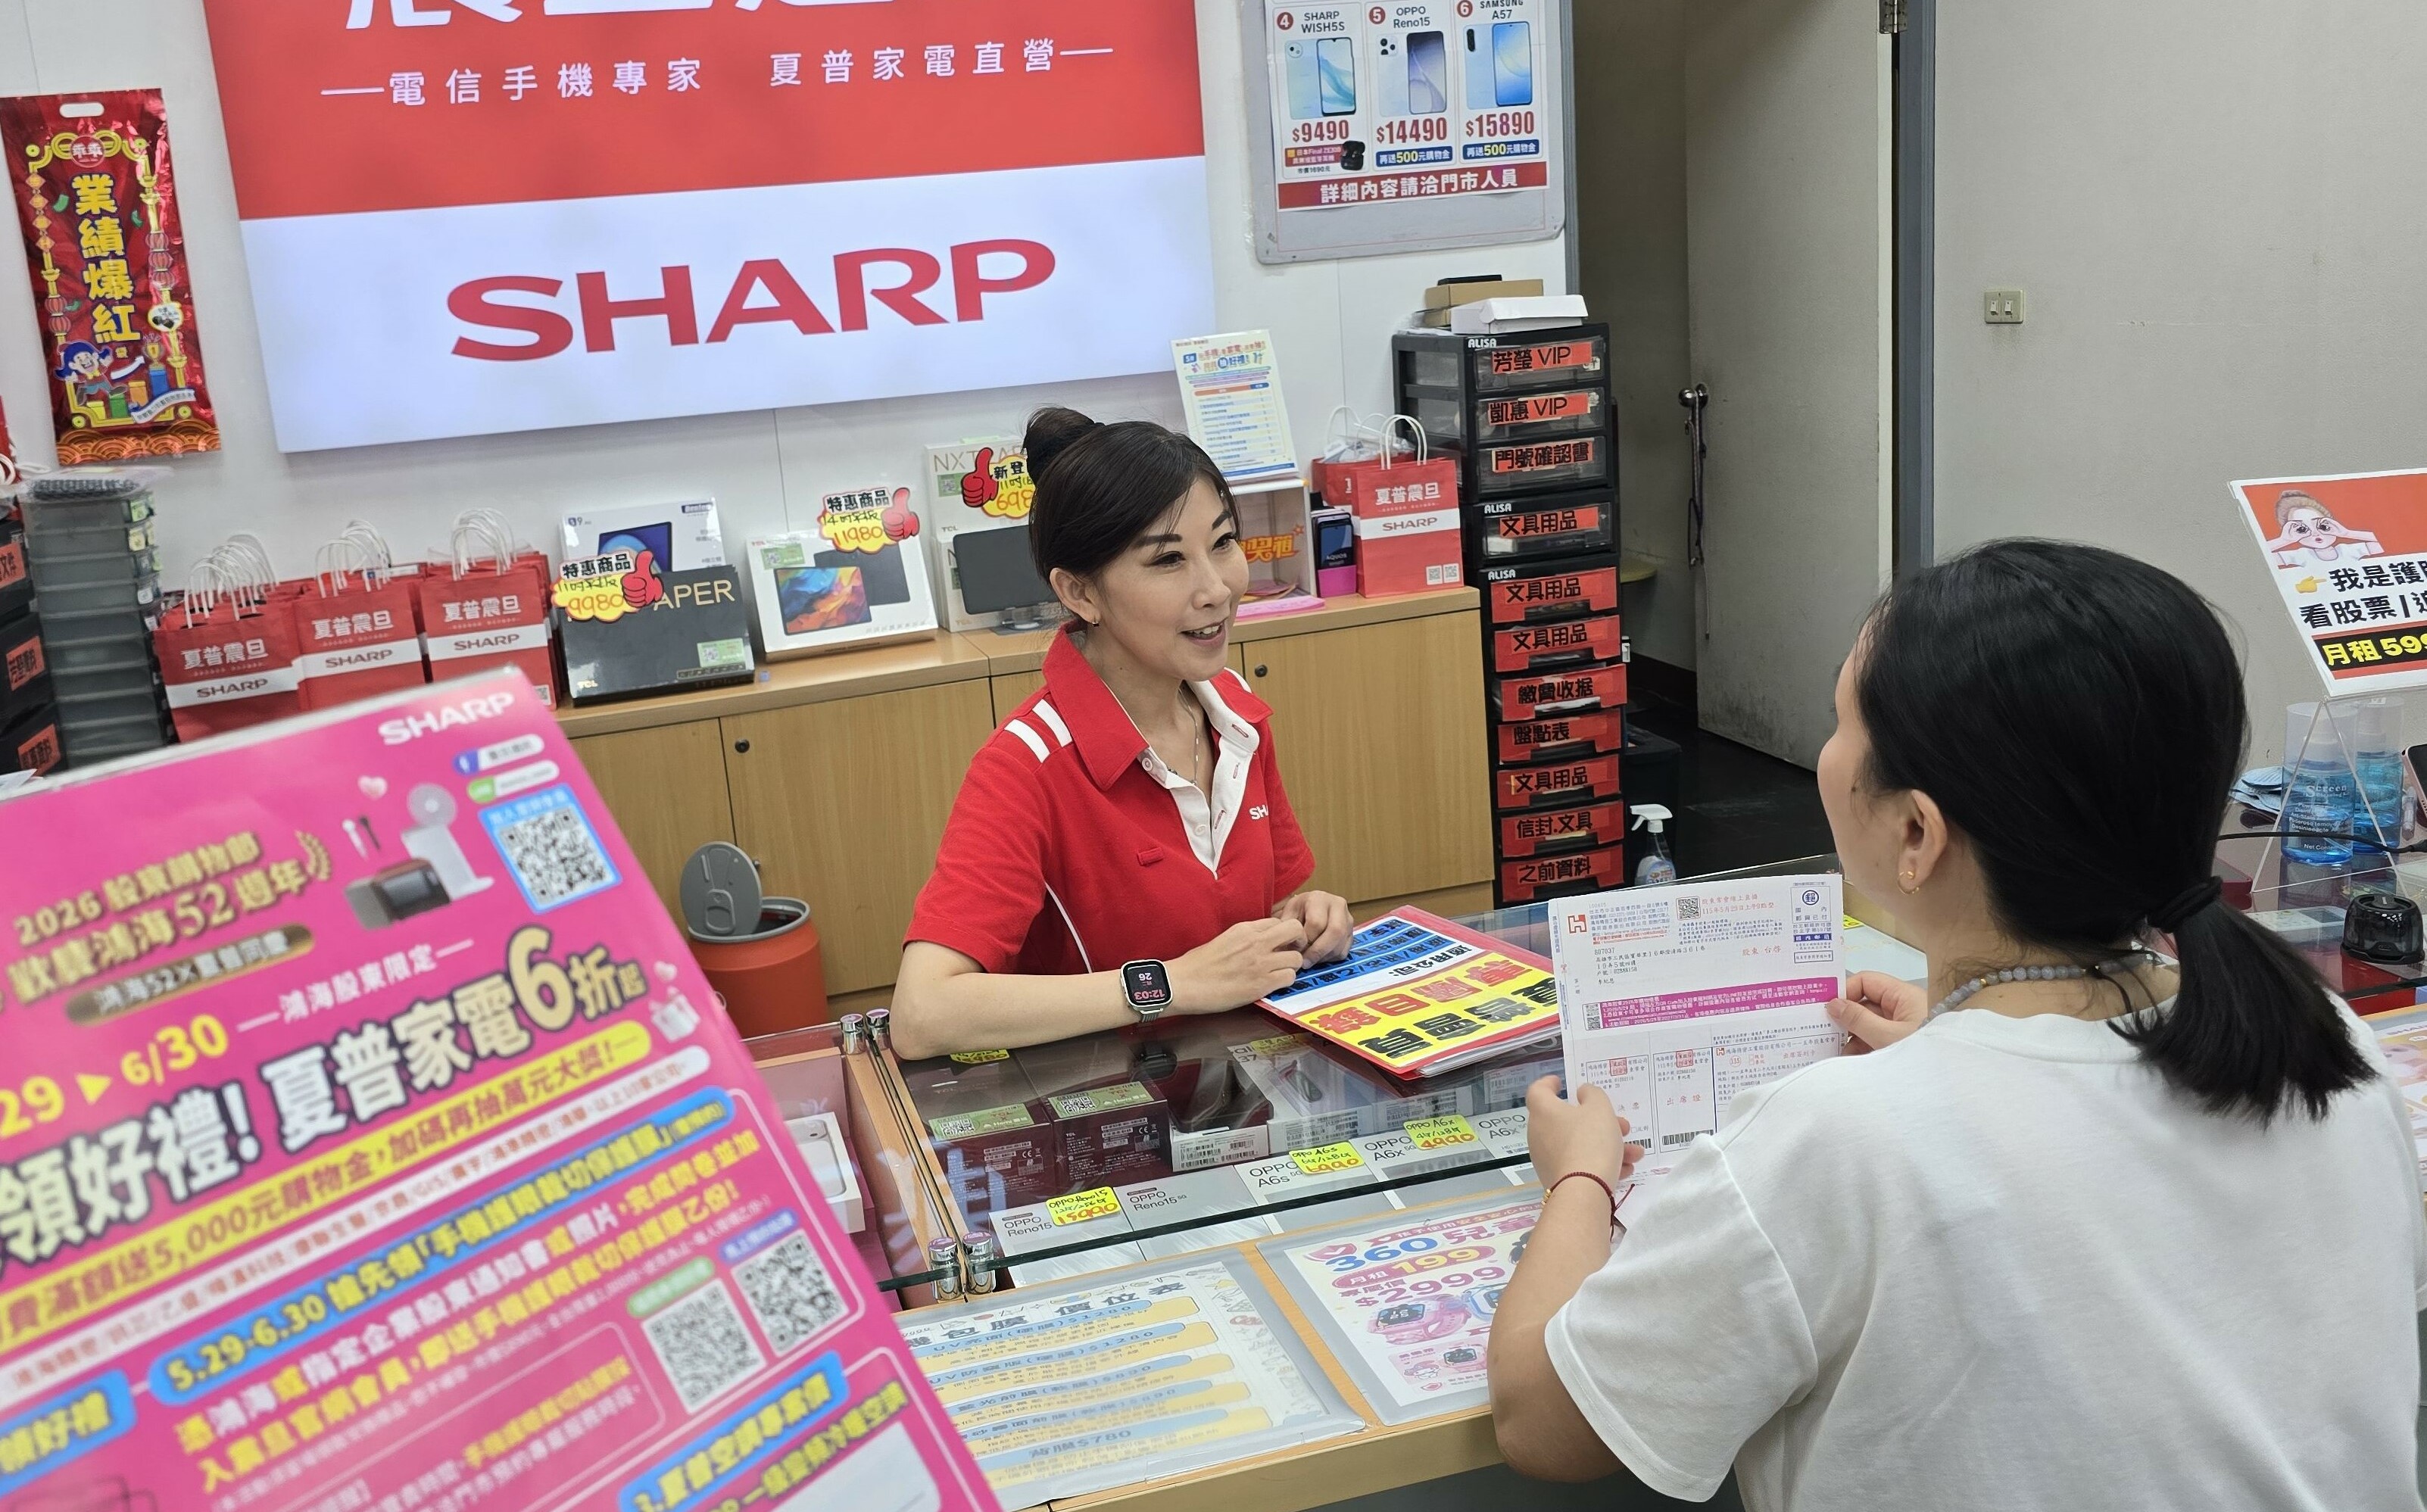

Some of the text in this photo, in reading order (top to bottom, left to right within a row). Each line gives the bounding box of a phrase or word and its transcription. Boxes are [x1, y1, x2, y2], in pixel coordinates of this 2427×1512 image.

[1304, 11, 1340, 21] SHARP
[1374, 9, 1381, 22] 5
[1396, 6, 1427, 16] OPPO
[1461, 2, 1470, 15] 6
[1492, 9, 1512, 20] A57
[1281, 15, 1290, 27] 4
[1301, 21, 1346, 33] WISH5S
[1393, 17, 1430, 29] Reno15
[389, 38, 1054, 106] 電信手機專家 夏普家電直營
[1293, 119, 1350, 143] $9490
[1377, 117, 1448, 145] $14490
[1465, 111, 1535, 139] $15890
[1320, 168, 1519, 204] 詳細內容請洽門市人員
[72, 173, 142, 344] 業績爆紅
[447, 238, 1056, 362] SHARP
[1468, 338, 1497, 348] ALISA
[1537, 347, 1571, 366] VIP
[1533, 397, 1568, 417] VIP
[1494, 441, 1589, 471] 門號確認書
[994, 461, 1025, 480] 新登
[826, 489, 890, 512] 特惠商品
[996, 490, 1033, 510] 698
[1374, 482, 1441, 506] 夏普震旦
[1484, 503, 1511, 513] ALISA
[1382, 517, 1438, 532] SHARP
[1501, 510, 1577, 537] 文具用品
[834, 526, 883, 544] 11980
[562, 553, 631, 578] 特惠商品
[1488, 569, 1516, 581] ALISA
[653, 578, 735, 611] APER
[1505, 578, 1581, 603] 文具用品
[443, 594, 521, 624] 夏普震旦
[568, 593, 624, 615] 9980
[311, 609, 394, 641] 夏普震旦
[454, 633, 519, 651] SHARP
[1512, 623, 1587, 652] 文具用品
[180, 638, 269, 671] 夏普震旦
[325, 649, 393, 669] SHARP
[2322, 638, 2383, 666] 月租
[196, 678, 269, 698] SHARP
[577, 679, 598, 689] TCL
[378, 691, 515, 746] SHARP
[1514, 722, 1570, 745] 盤點表
[1515, 766, 1589, 793] 文具用品
[1519, 856, 1592, 884] 之前資料
[13, 890, 104, 947] 2026
[1388, 944, 1474, 977] 適用公司:
[1139, 972, 1153, 981] 26
[1134, 989, 1165, 1001] 12:03
[1309, 959, 1533, 1035] 專屬目錄
[120, 1014, 229, 1086] 6/30
[1433, 1118, 1455, 1129] A6x
[1478, 1114, 1526, 1130] OPPO
[1421, 1133, 1475, 1149] 4990
[1490, 1127, 1518, 1139] A6x
[1365, 1135, 1412, 1152] OPPO
[1374, 1149, 1405, 1161] A6x
[1249, 1161, 1298, 1178] OPPO
[1306, 1158, 1359, 1174] 6990
[1258, 1174, 1290, 1188] A6s
[1129, 1191, 1166, 1204] OPPO
[1134, 1196, 1178, 1211] Reno15
[1004, 1215, 1042, 1229] OPPO
[1008, 1221, 1053, 1237] Reno15
[1325, 1215, 1539, 1272] 360 兒童
[1349, 1247, 1480, 1286] 月租 199
[1355, 1266, 1505, 1307] $2999
[1055, 1281, 1187, 1317] 價位表
